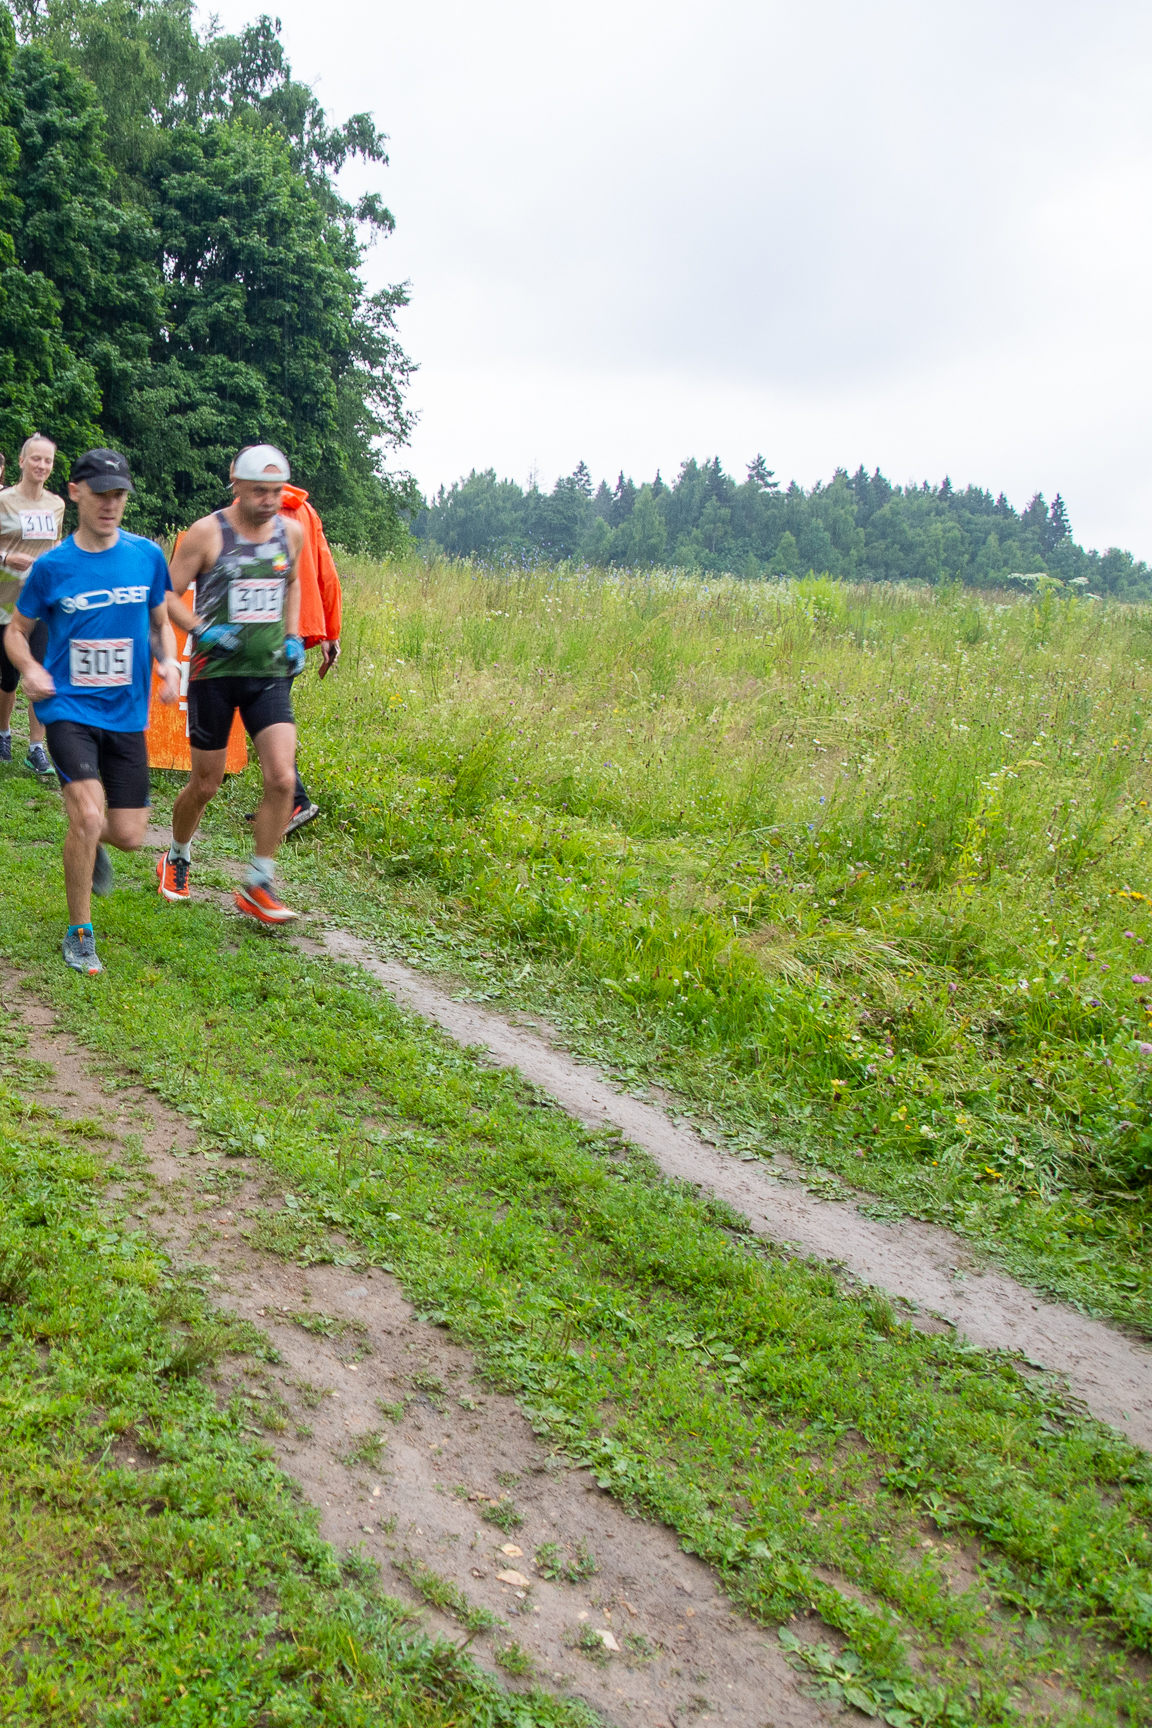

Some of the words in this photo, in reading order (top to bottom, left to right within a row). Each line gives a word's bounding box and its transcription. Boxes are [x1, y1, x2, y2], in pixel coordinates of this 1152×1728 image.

[25, 515, 54, 532] 310
[237, 588, 278, 611] 303
[77, 649, 126, 675] 305
